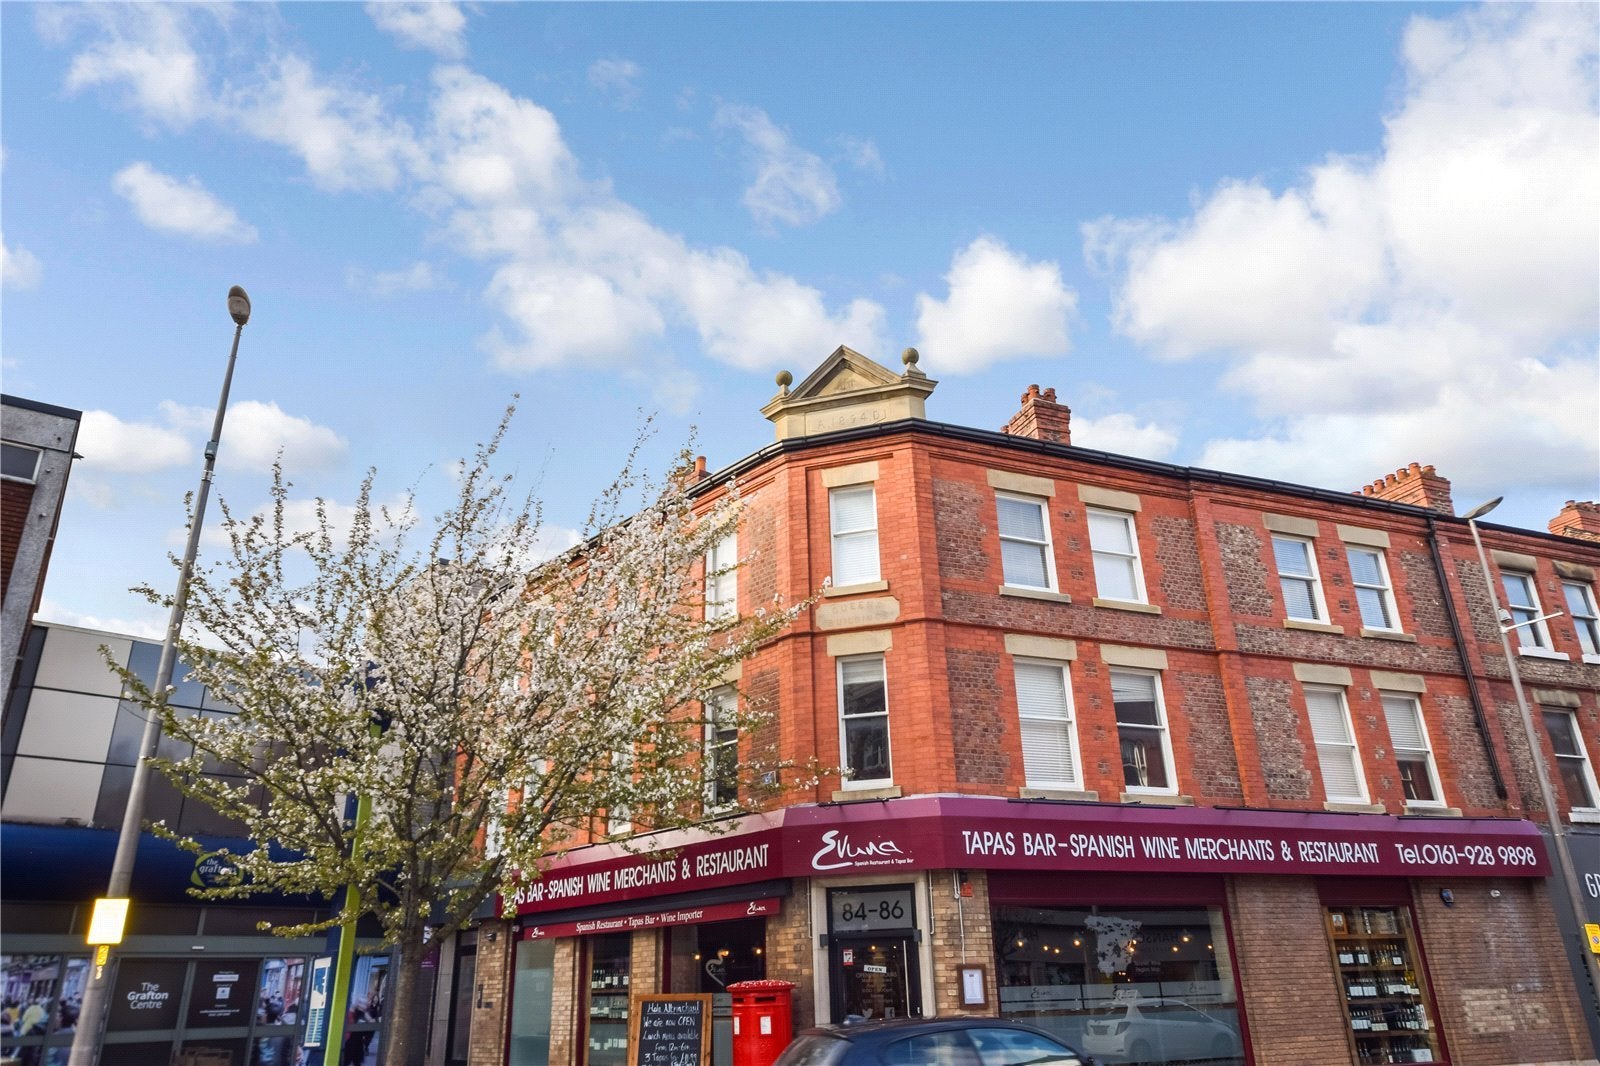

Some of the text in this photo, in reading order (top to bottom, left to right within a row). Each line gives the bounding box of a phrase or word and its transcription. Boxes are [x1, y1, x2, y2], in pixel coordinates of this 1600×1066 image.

[811, 829, 904, 870] Evuna
[962, 831, 1016, 856] TAPAS
[1022, 832, 1135, 858] BAR-SPANISH
[1140, 836, 1181, 859] WINE
[1184, 837, 1275, 861] MERCHANTS
[1280, 840, 1294, 861] &
[1297, 840, 1380, 864] RESTAURANT
[1497, 845, 1537, 866] 9898
[587, 871, 611, 893] WINE
[614, 861, 676, 890] MERCHANTS
[681, 858, 691, 879] &
[696, 844, 769, 877] RESTAURANT
[842, 900, 904, 921] 84-86
[576, 910, 703, 934] Spanish Restaurant Tapas Bar Wine Importer
[141, 982, 159, 991] The
[127, 991, 169, 1001] Grafton
[130, 1000, 163, 1010] Centre
[678, 1016, 695, 1026] OPEN
[644, 1053, 651, 1062] 3
